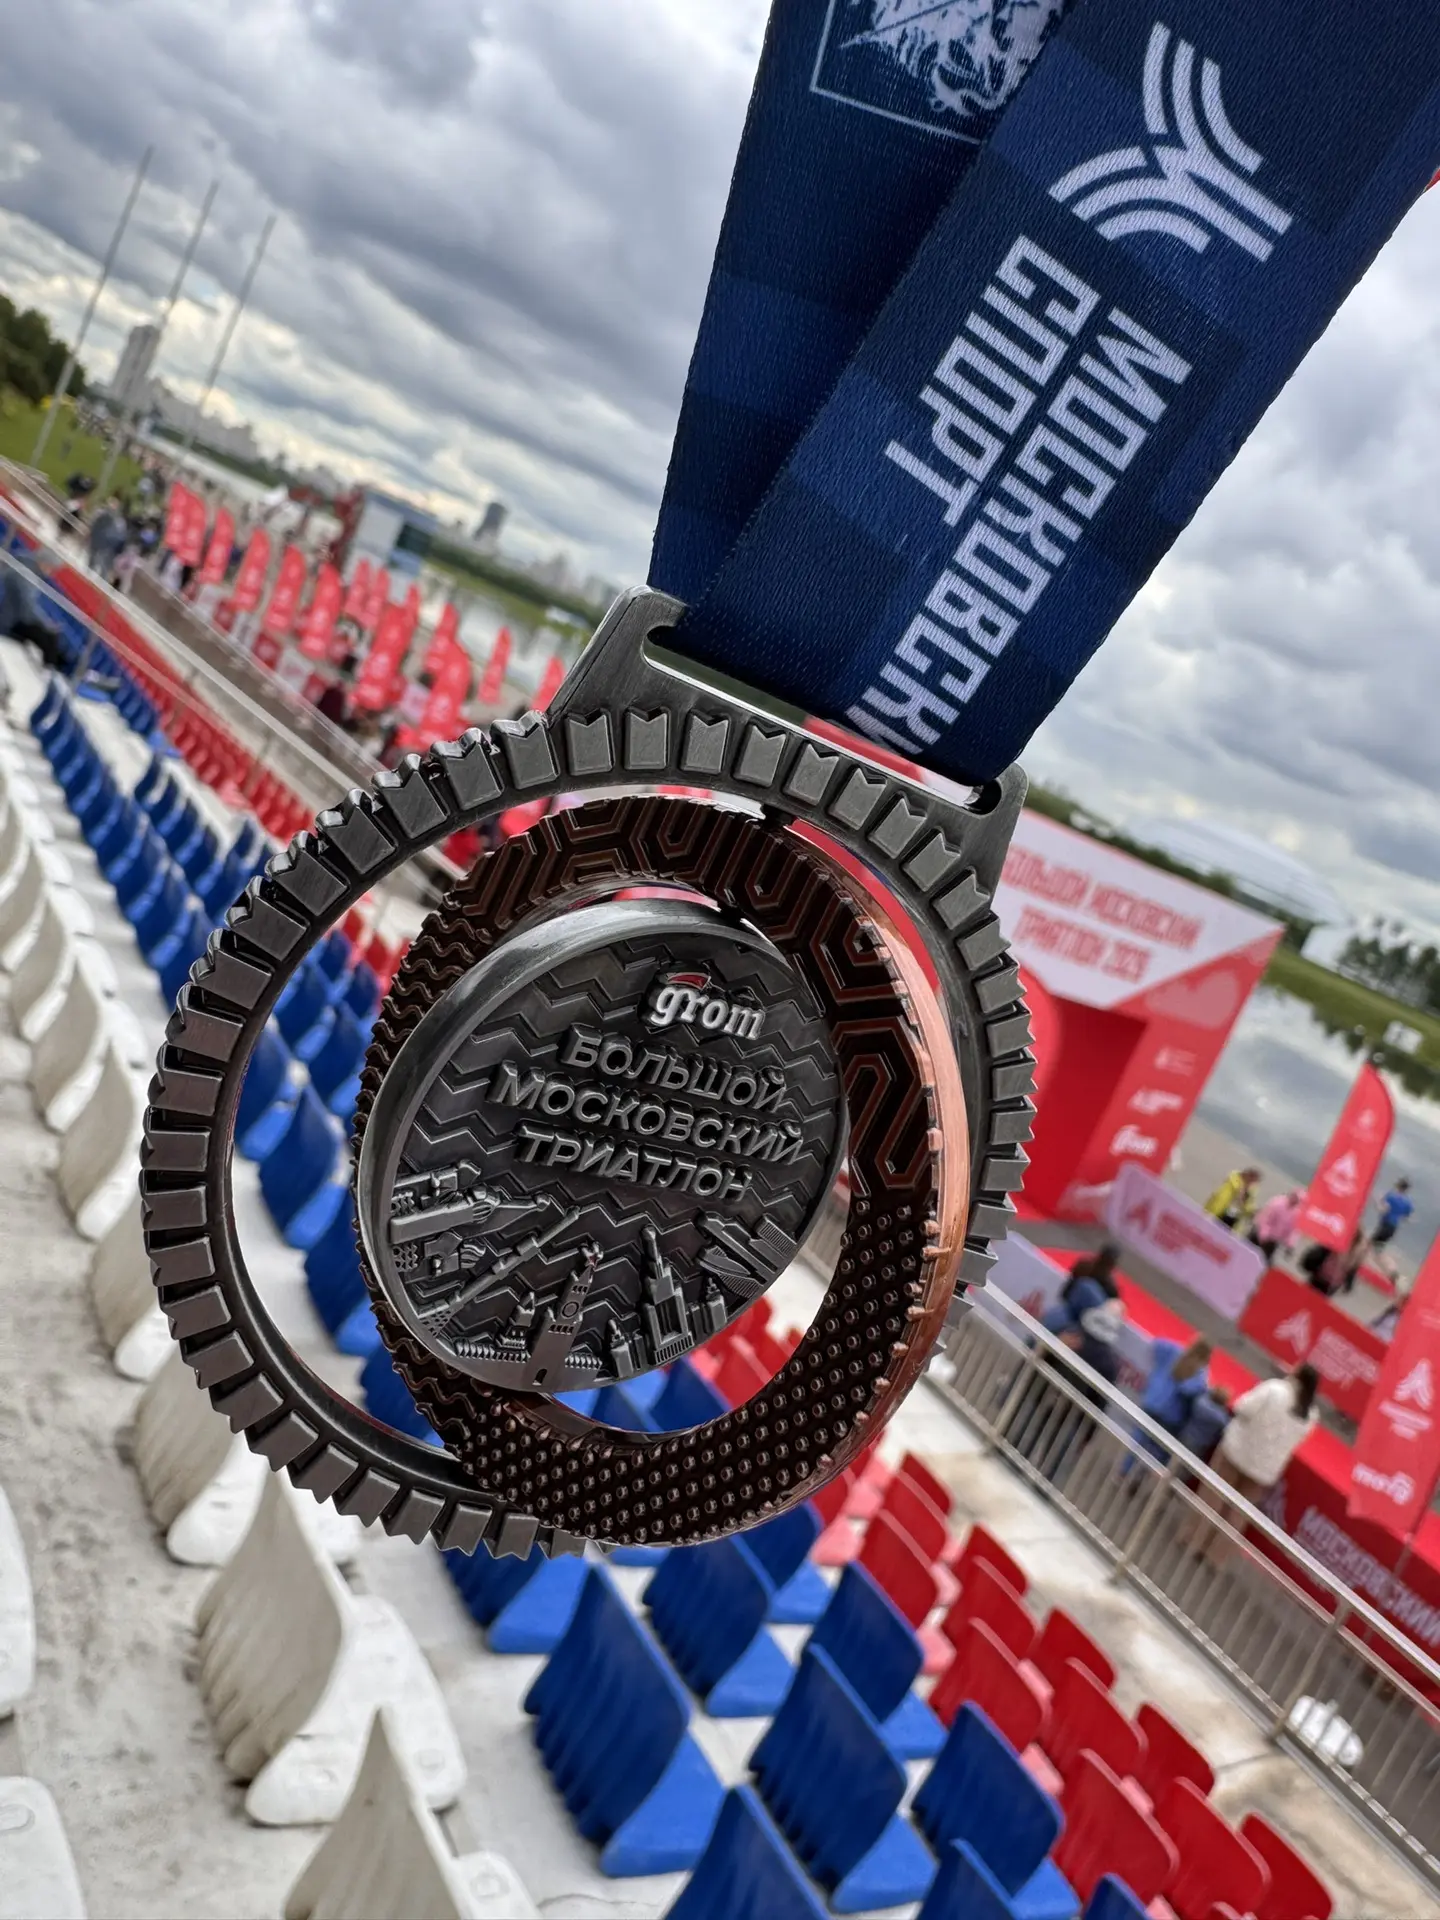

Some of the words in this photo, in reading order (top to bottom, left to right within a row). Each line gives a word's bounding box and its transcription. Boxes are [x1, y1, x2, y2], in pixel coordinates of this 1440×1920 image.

[884, 234, 1101, 527] СПОРТ
[651, 986, 766, 1039] grom
[490, 1060, 804, 1164] МОСКОВСКИЙ
[562, 1023, 787, 1113] БОЛЬШОЙ
[517, 1120, 753, 1200] ТРИАТЛОН
